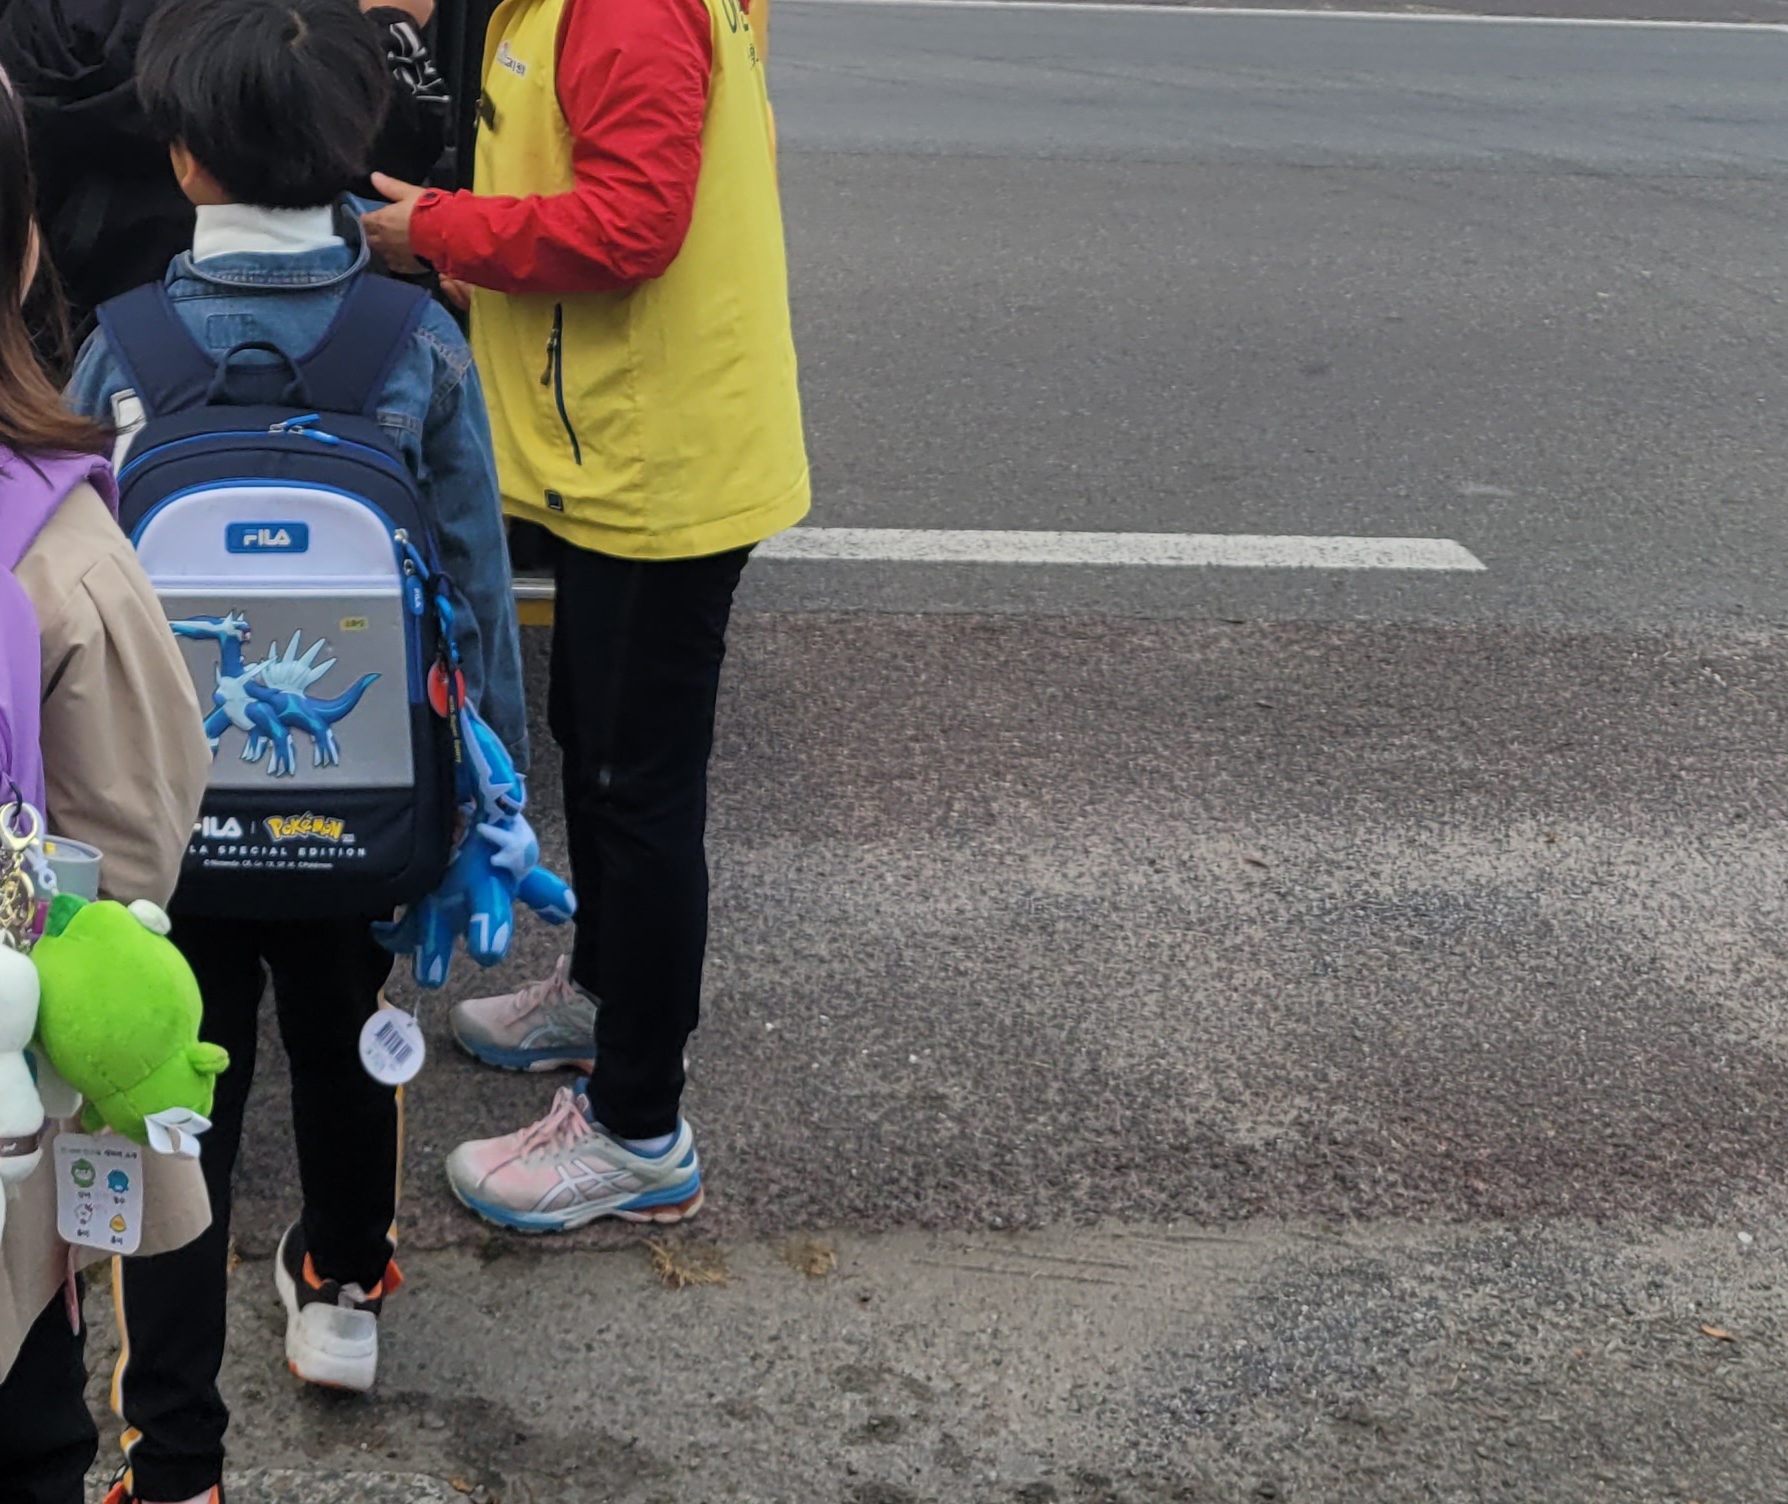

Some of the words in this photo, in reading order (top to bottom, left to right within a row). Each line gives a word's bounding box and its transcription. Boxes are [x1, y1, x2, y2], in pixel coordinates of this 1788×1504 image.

[243, 528, 291, 546] FILA
[218, 846, 288, 857] SPECIAL
[298, 847, 366, 858] EDITION
